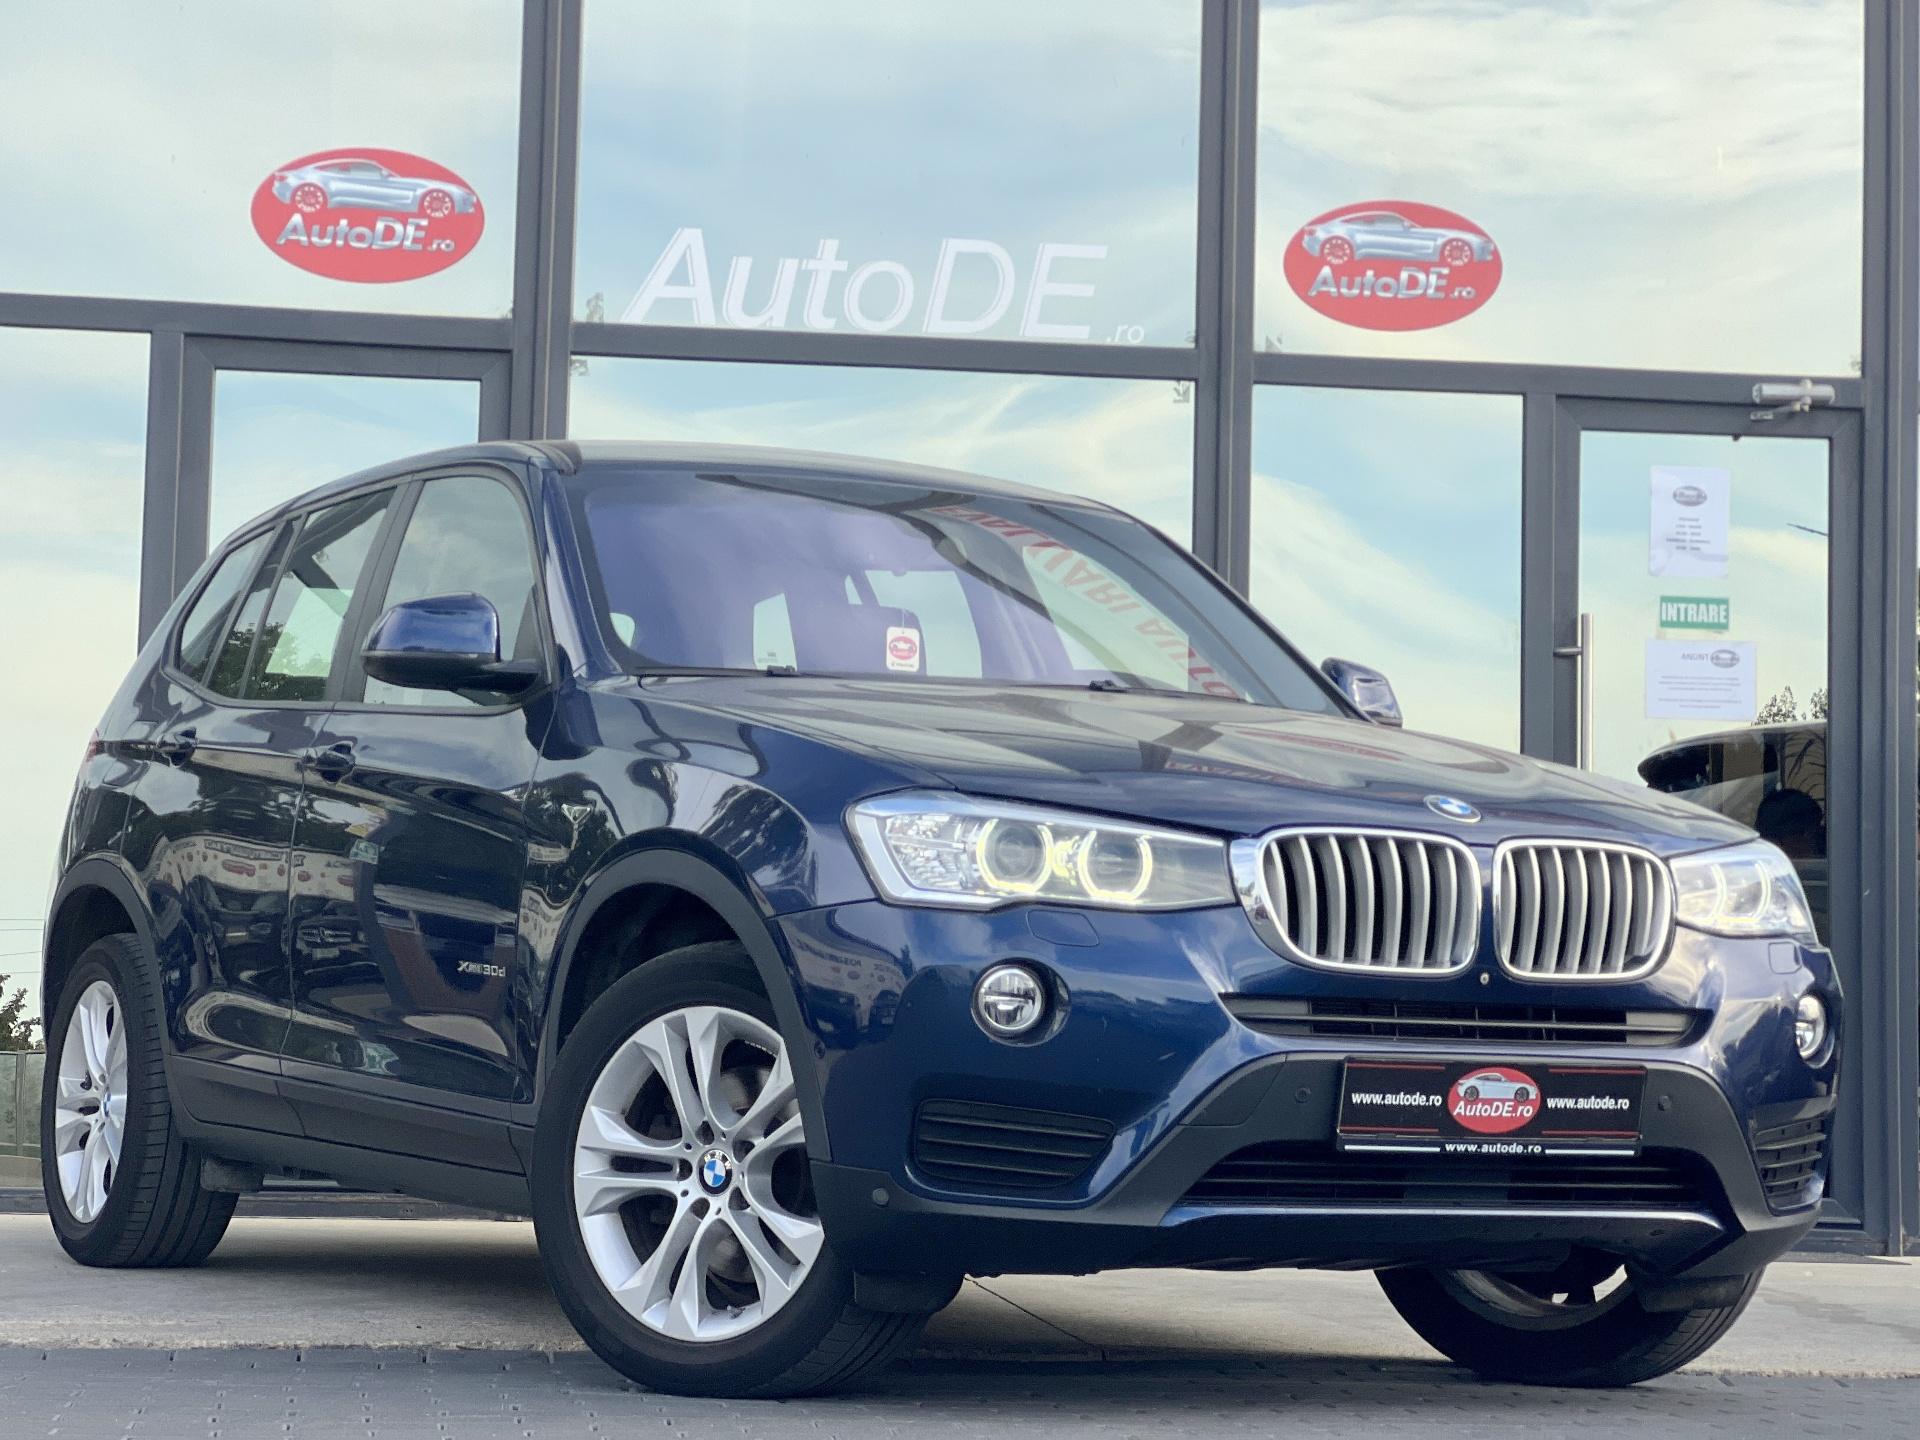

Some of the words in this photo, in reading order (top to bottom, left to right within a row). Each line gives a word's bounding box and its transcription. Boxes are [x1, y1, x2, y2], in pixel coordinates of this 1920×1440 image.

[1661, 602, 1727, 624] INTRARE
[1351, 1091, 1442, 1107] www.autode.ro
[1546, 1096, 1629, 1110] www.autode.ro
[1453, 1100, 1533, 1118] AutoDE.ro
[1445, 1142, 1542, 1154] www.autode.ro
